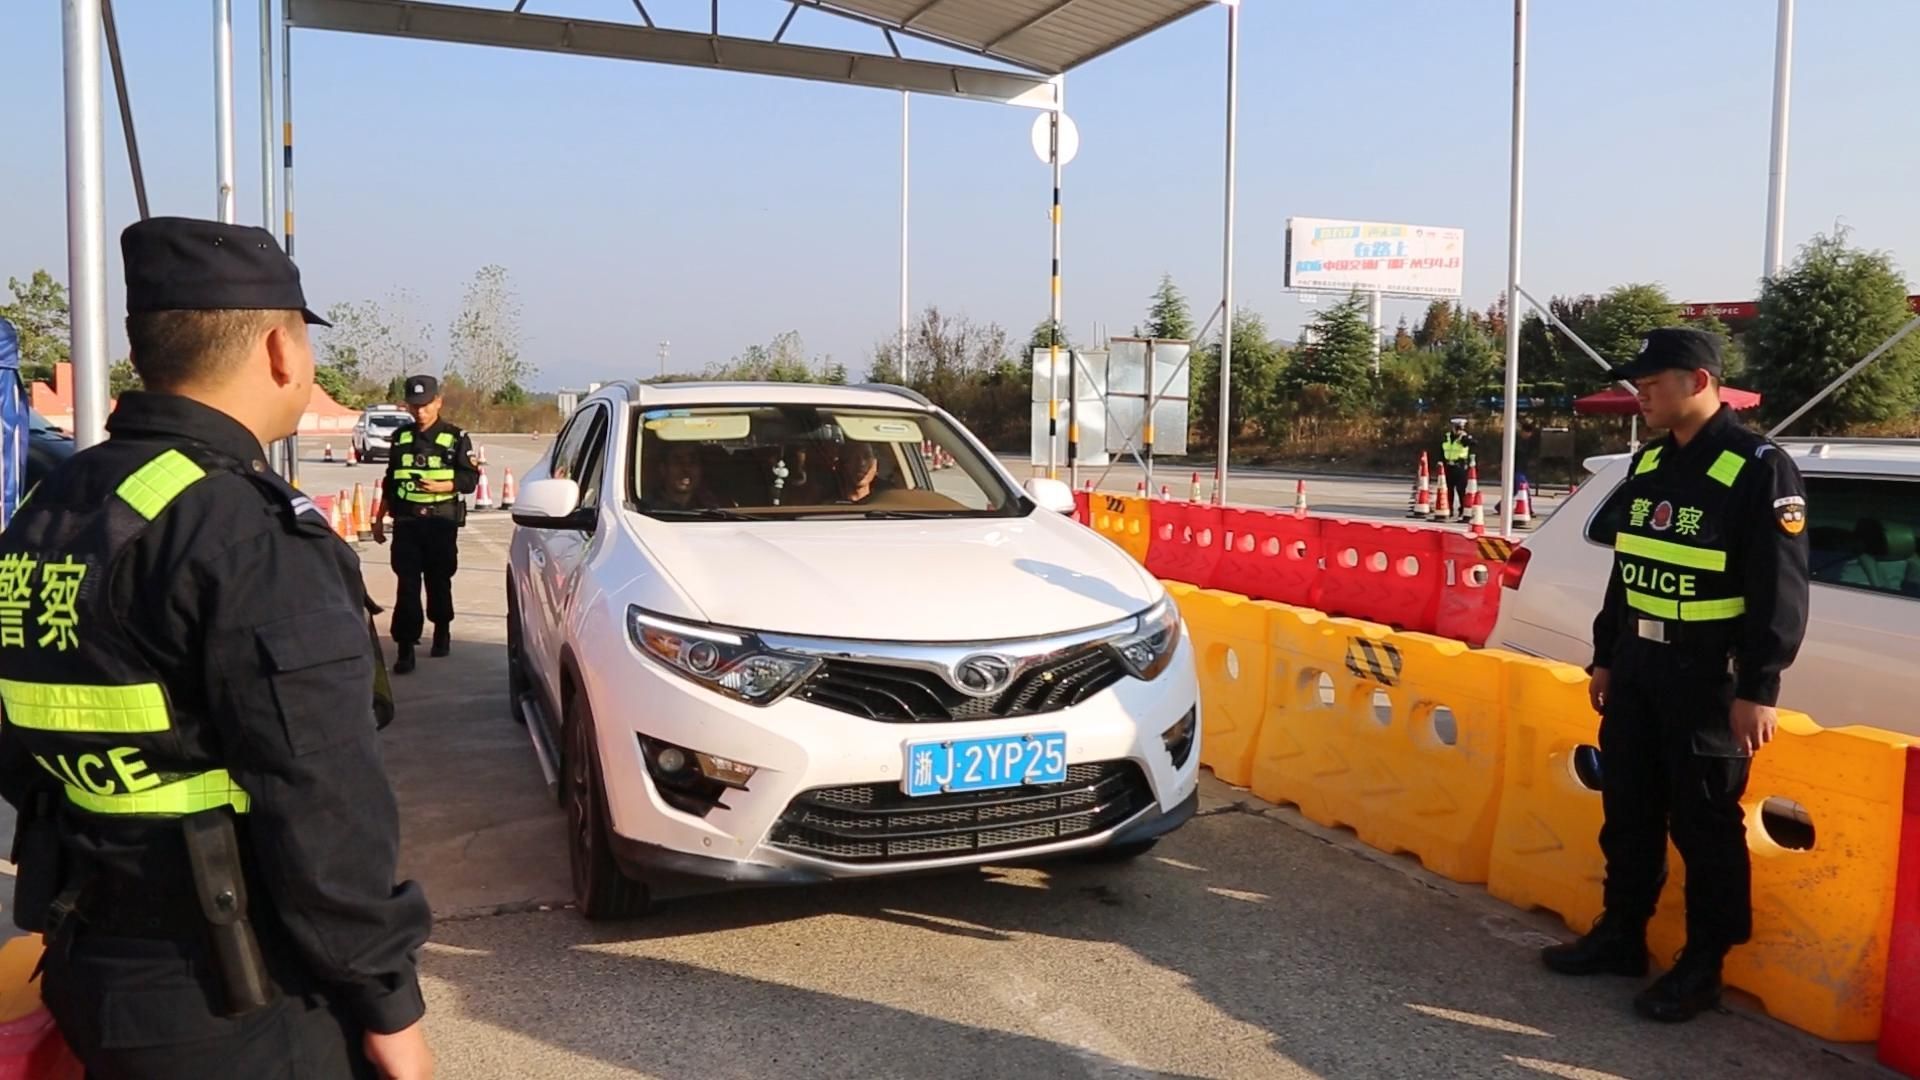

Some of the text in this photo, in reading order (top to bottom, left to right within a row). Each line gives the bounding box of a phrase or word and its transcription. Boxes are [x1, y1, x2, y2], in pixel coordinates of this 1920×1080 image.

[1629, 498, 1703, 535] 警察
[1619, 560, 1696, 596] OLICE
[0, 552, 87, 651] 警察
